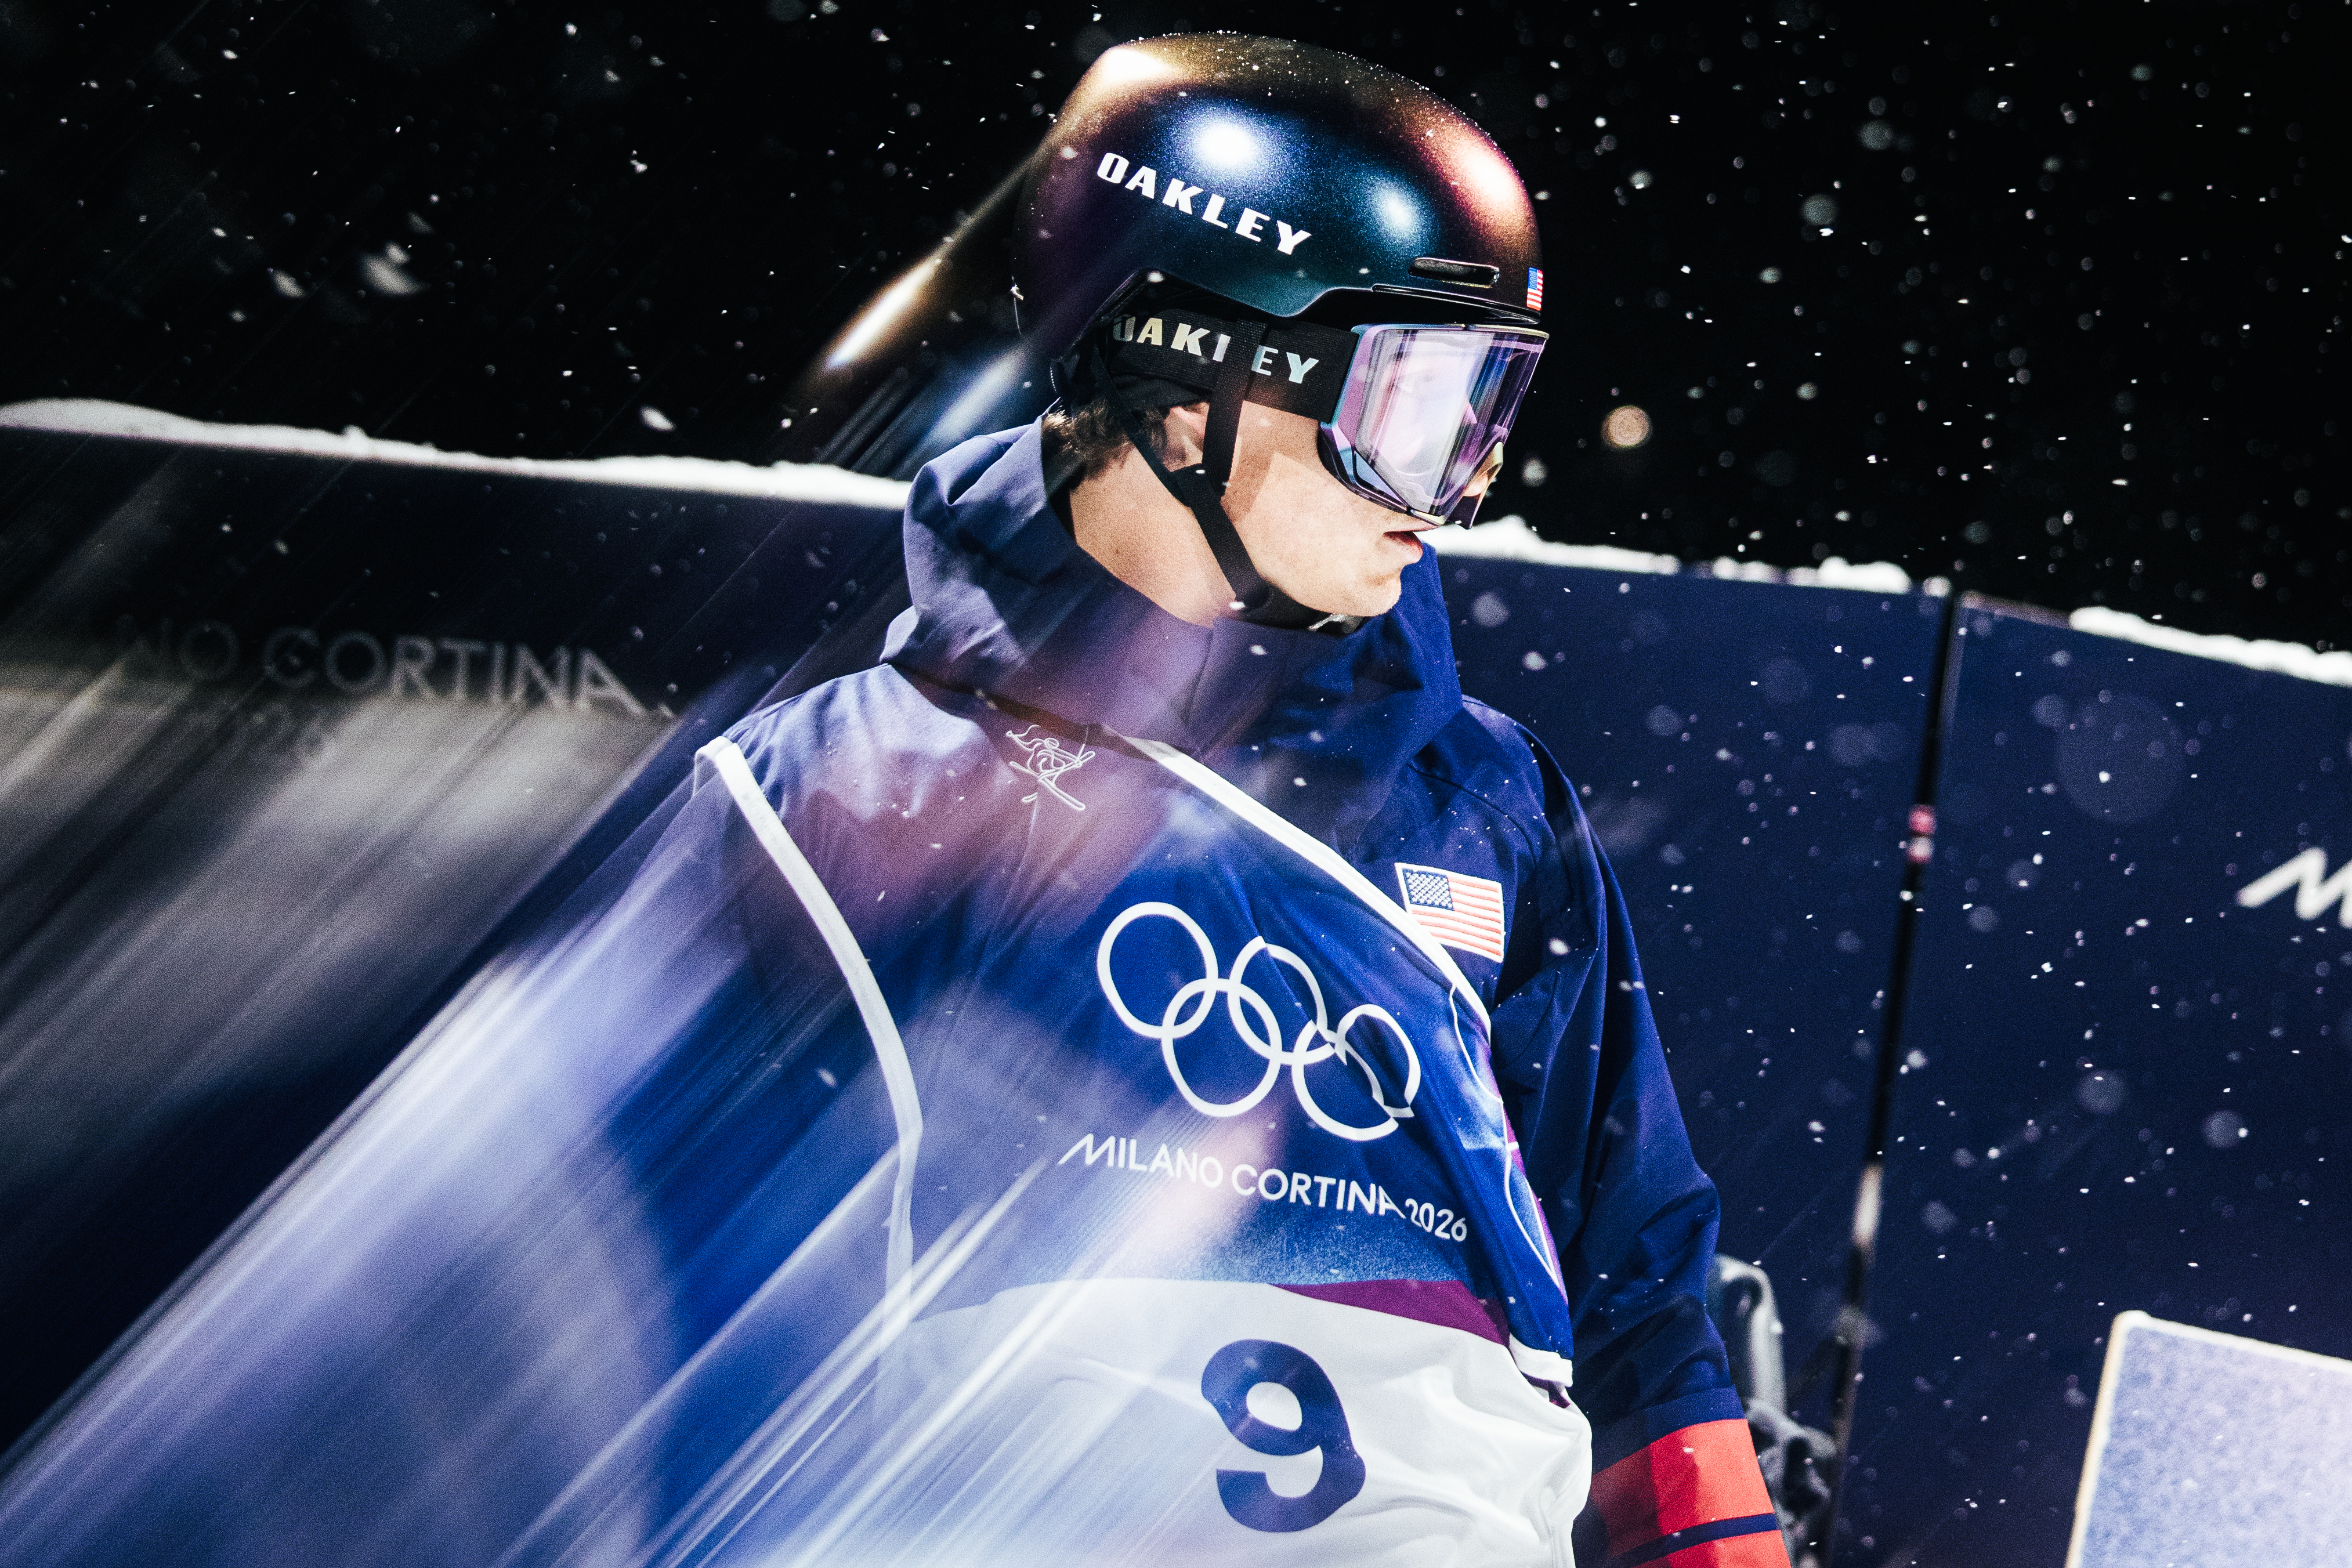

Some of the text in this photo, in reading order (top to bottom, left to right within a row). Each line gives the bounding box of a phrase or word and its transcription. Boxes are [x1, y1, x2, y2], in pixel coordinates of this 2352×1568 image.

[1097, 152, 1312, 255] OAKLEY
[261, 625, 646, 718] CORTINA
[1058, 1133, 1467, 1242] MILANO CORTINA 2026
[1200, 1338, 1366, 1533] 9
